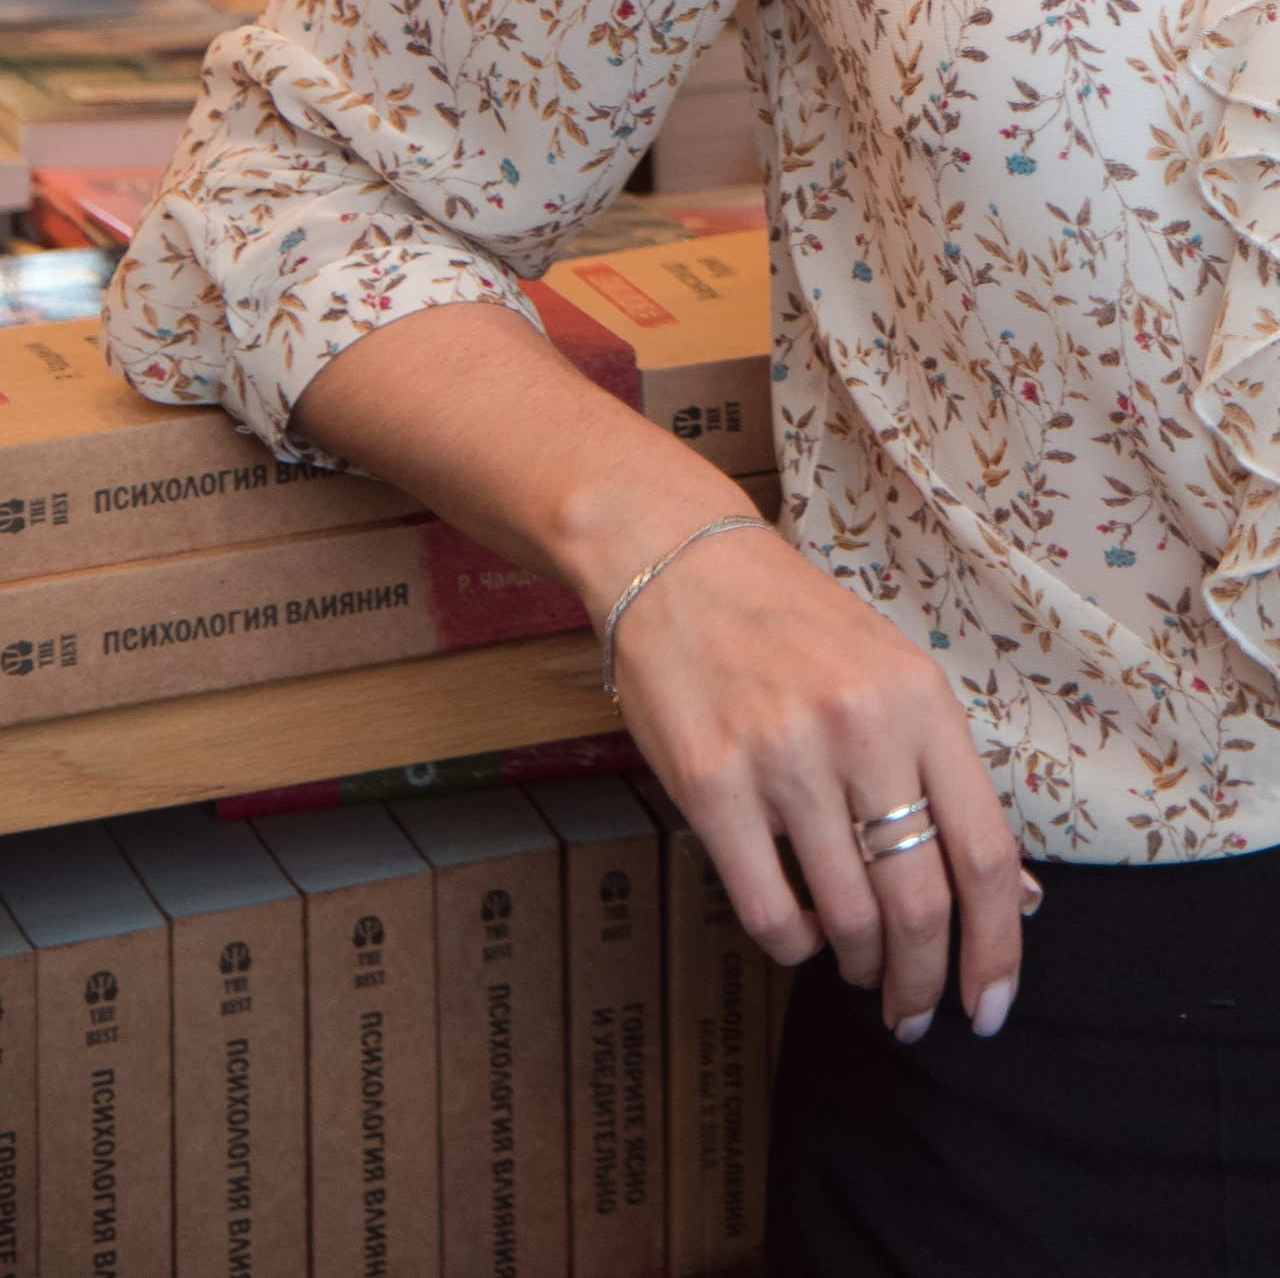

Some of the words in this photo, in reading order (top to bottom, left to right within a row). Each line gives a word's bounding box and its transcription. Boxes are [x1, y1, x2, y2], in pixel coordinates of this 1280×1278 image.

[29, 498, 46, 525] THE
[52, 492, 69, 525] BEST
[93, 464, 268, 514] ПСИХОЛОГИЯ
[102, 603, 279, 655] ПСИХОЛОГИЯ
[284, 582, 410, 625] ВЛИЯНИЯ
[38, 639, 55, 668] THE
[60, 633, 78, 668] BEST
[220, 996, 252, 1016] BEST
[224, 975, 248, 993] THE
[86, 1026, 118, 1048] BEST
[89, 1005, 115, 1024] THE
[591, 1007, 614, 1027] И
[487, 983, 515, 1153] ПСИХОЛОГИЯ
[621, 1002, 645, 1129] ГОВОРИТЕ
[360, 1009, 386, 1183] ПСИХОЛОГИЯ
[226, 1038, 251, 1212] ПСИХОЛОГИЯ
[591, 1031, 617, 1216] УБЕДИТЕЛЬНО
[91, 1068, 117, 1244] ПСИХОЛОГИЯ
[624, 1136, 647, 1206] ЯСНО
[364, 1187, 388, 1278] ВЛИЯН
